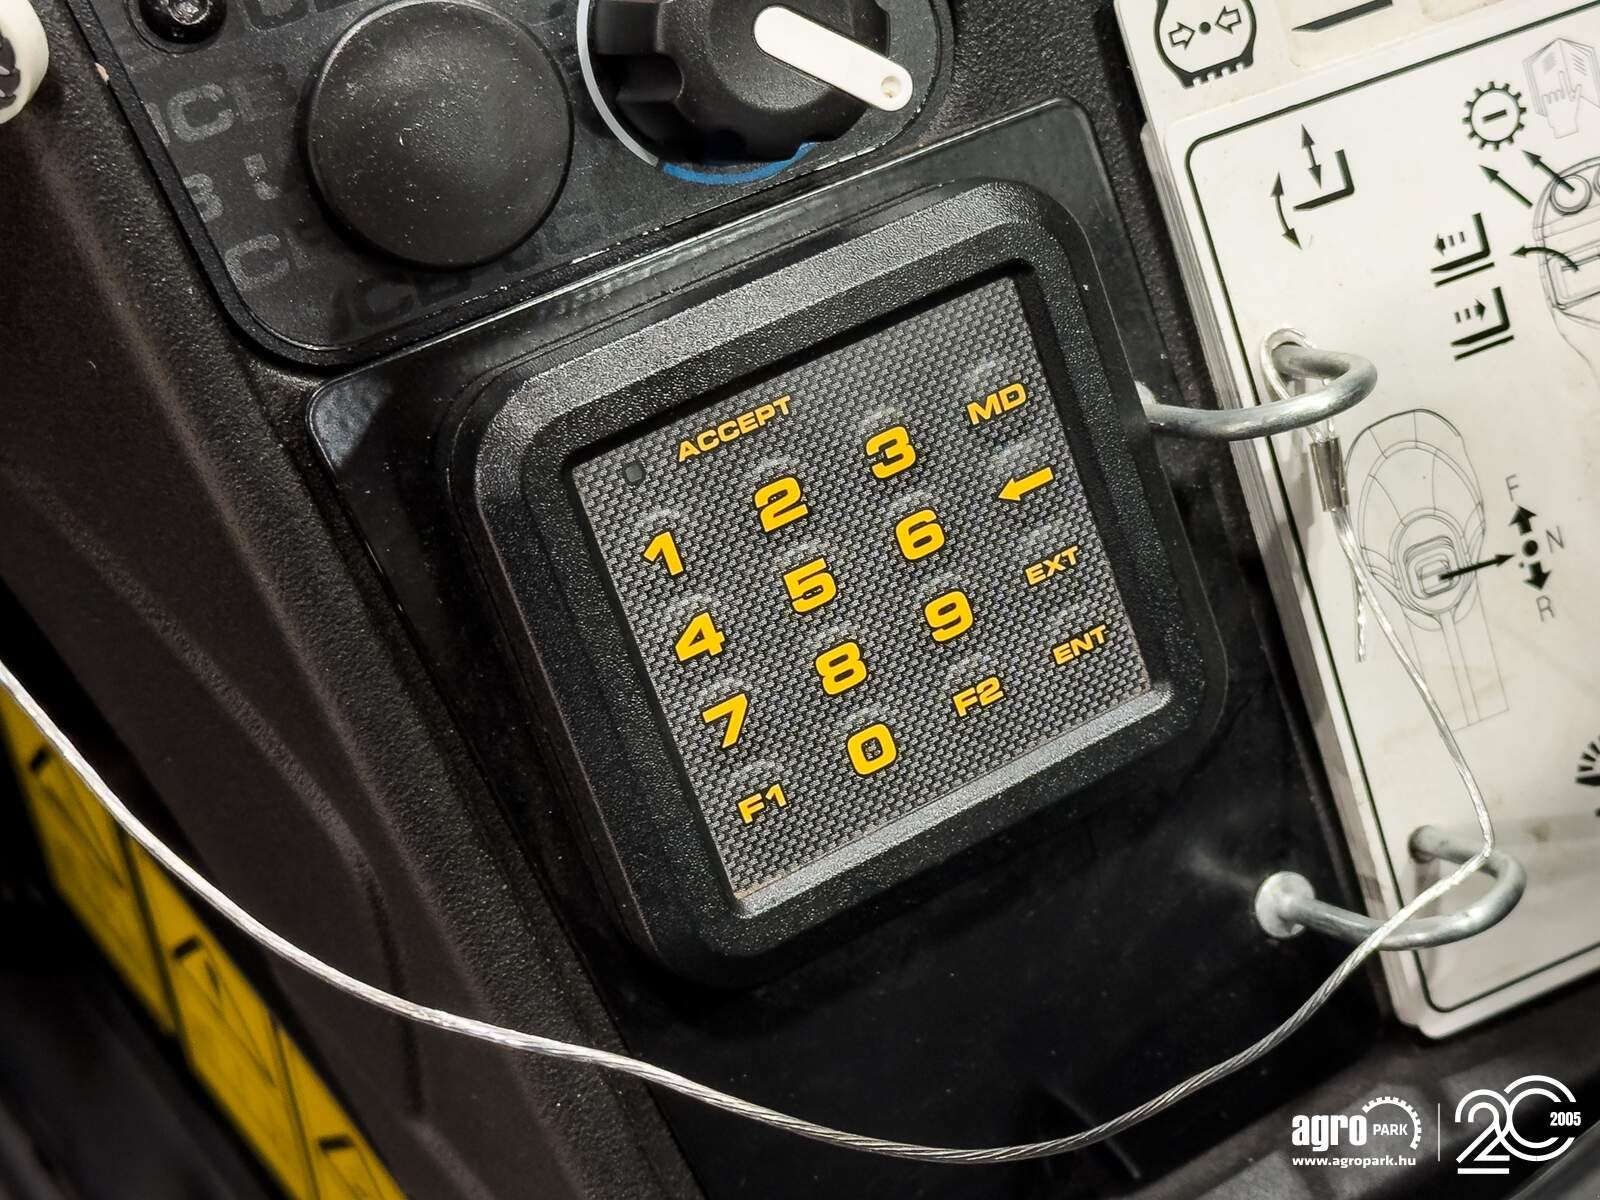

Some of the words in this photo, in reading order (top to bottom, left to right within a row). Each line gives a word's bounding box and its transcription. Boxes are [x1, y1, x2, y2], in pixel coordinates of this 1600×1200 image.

[967, 383, 1027, 424] MD
[678, 396, 790, 461] ACCEPT
[865, 426, 917, 479] 3
[754, 477, 809, 532] 2
[1504, 474, 1520, 502] F
[643, 532, 684, 576] 1
[895, 509, 945, 561] 6
[1546, 524, 1566, 553] N
[784, 558, 837, 613] 5
[1026, 546, 1078, 585] EXT
[924, 591, 974, 642] 9
[1535, 595, 1556, 623] R
[674, 612, 726, 661] 4
[1053, 625, 1107, 665] ENT
[815, 641, 868, 695] 8
[702, 694, 749, 748] 7
[953, 676, 1003, 717] F2
[847, 723, 897, 775] 0
[737, 784, 788, 823] F1
